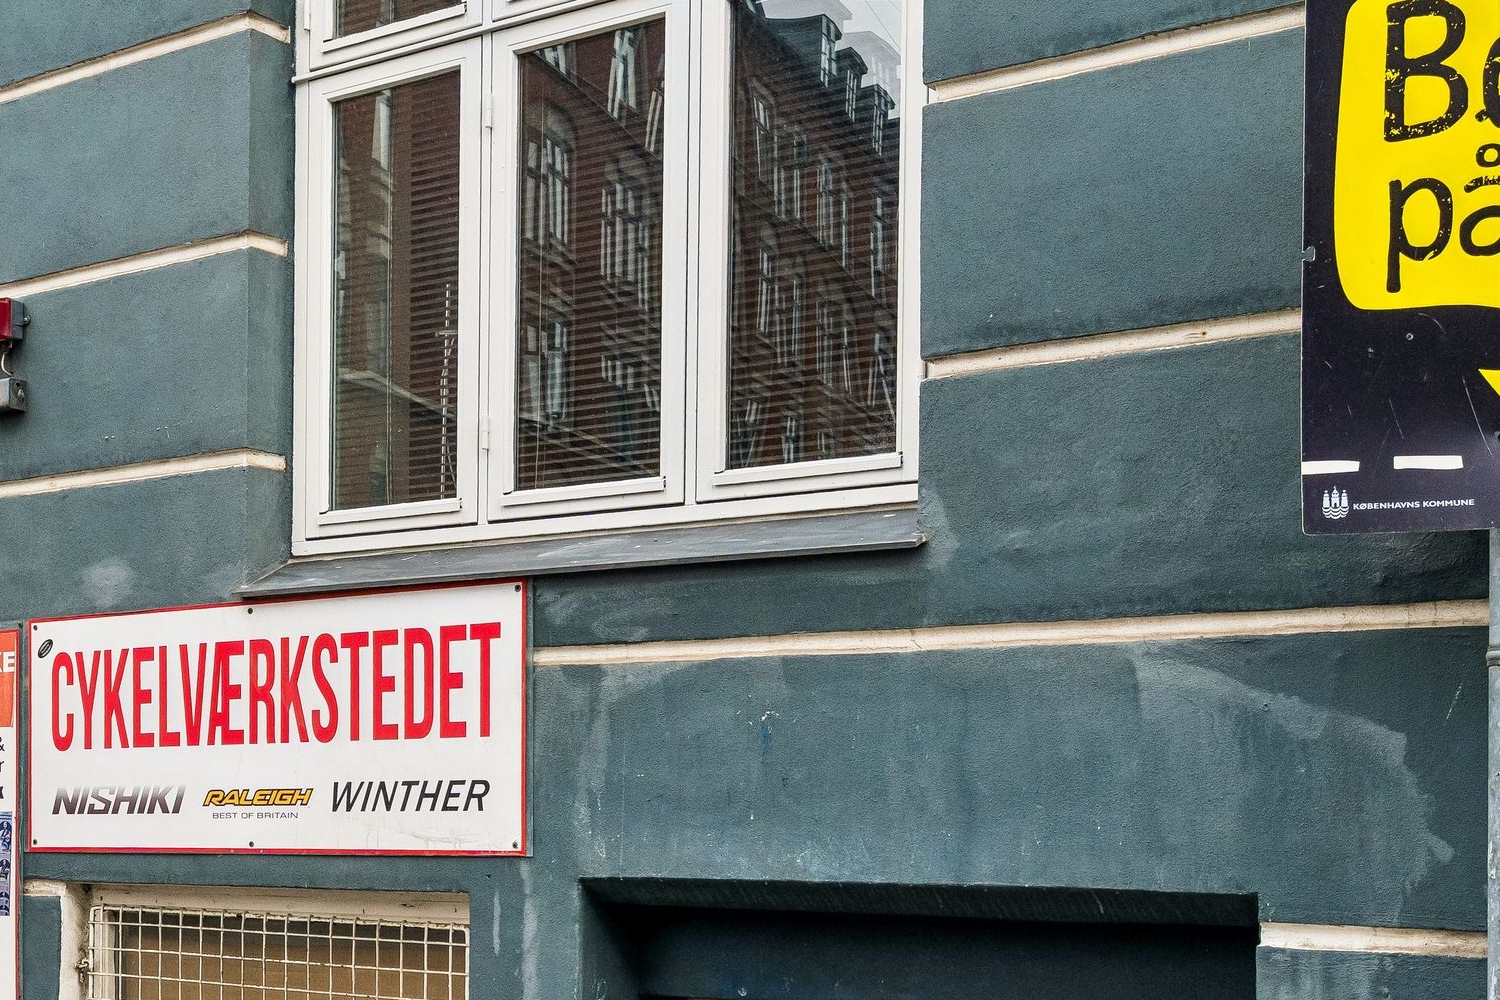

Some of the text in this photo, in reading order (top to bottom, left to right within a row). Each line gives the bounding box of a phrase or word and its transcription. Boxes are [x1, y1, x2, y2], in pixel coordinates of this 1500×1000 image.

[1383, 0, 1500, 141] B
[1353, 499, 1475, 510] KØBENHAVNS KOMMUNE
[52, 622, 501, 751] CYKELVÆRKSTEDET
[51, 785, 186, 815] NISHIKI
[203, 788, 314, 806] RALEIGH
[332, 780, 490, 812] WINTHER
